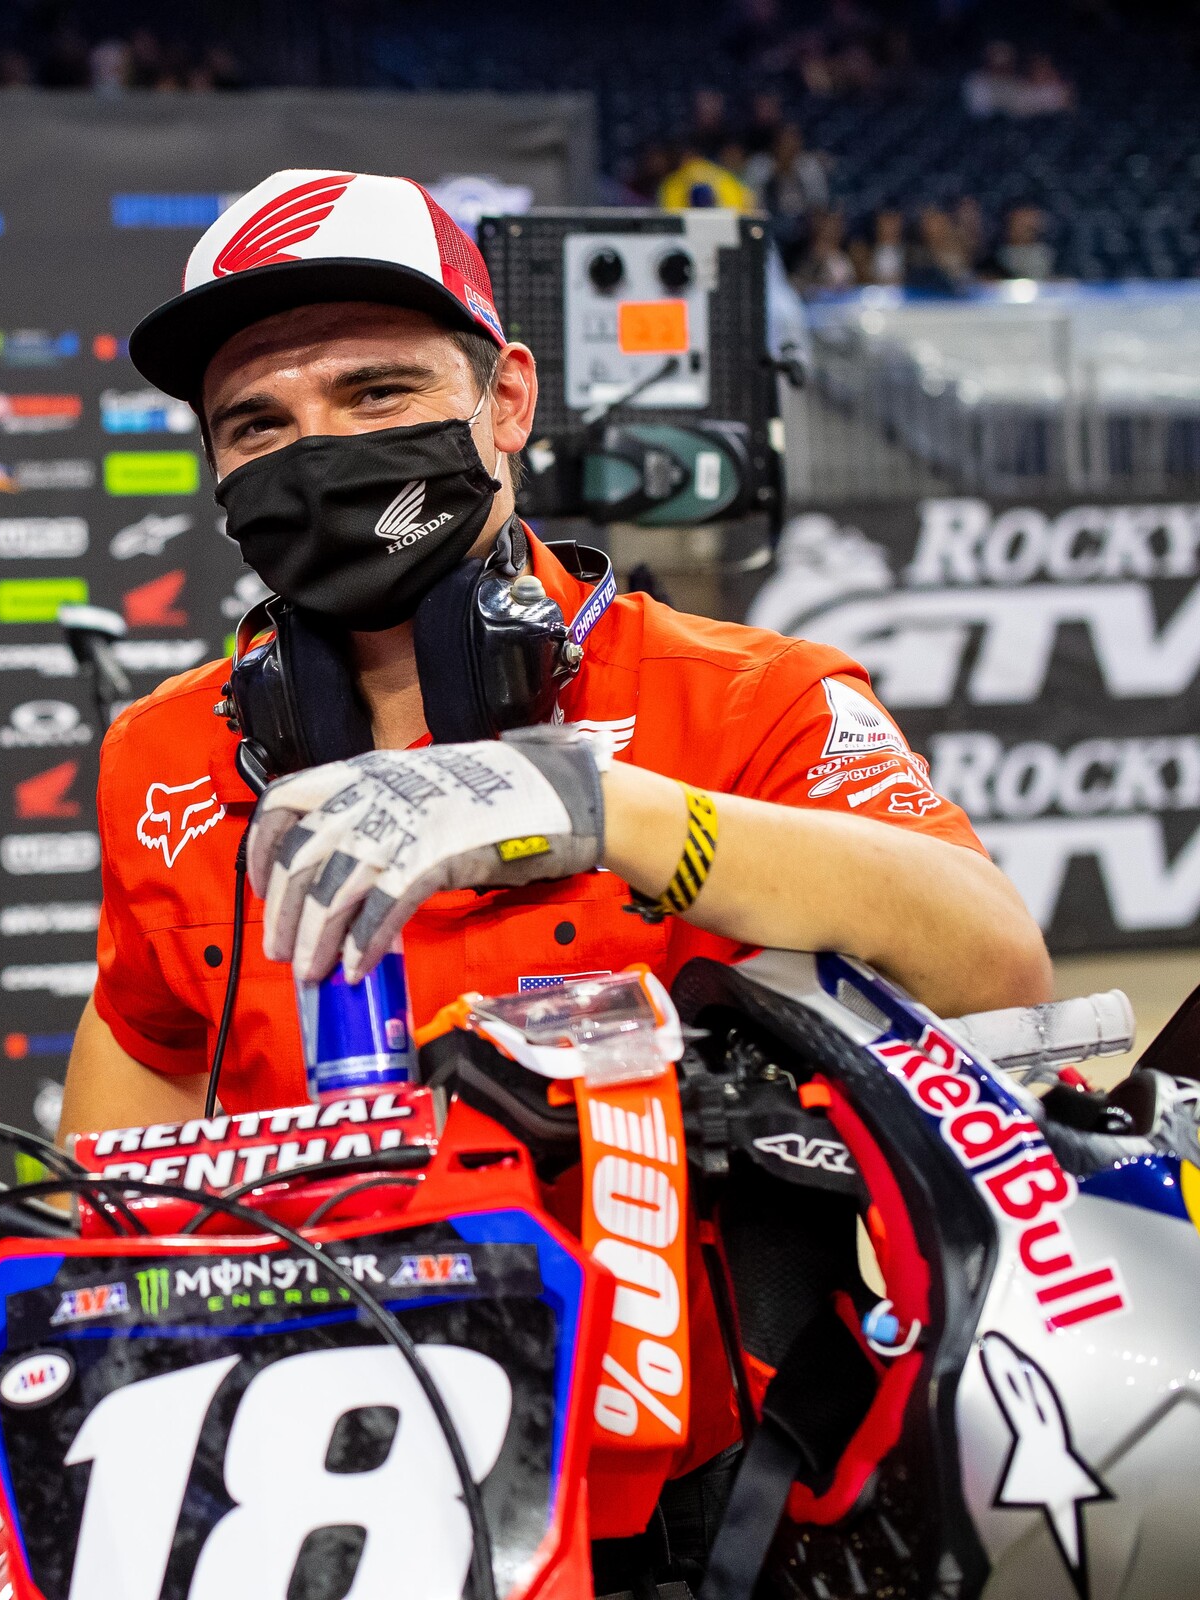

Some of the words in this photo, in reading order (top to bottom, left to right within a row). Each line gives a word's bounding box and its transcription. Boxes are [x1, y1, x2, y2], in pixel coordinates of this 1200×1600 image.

[386, 511, 455, 554] HONDA
[907, 498, 1200, 586] ROCKY
[839, 731, 864, 743] Pro
[94, 1092, 413, 1156] RENTHAL
[874, 1028, 1041, 1161] Red
[984, 1152, 1125, 1334] Bull
[175, 1253, 386, 1298] MONSTR
[588, 1096, 684, 1436] 100%
[63, 1342, 513, 1600] 18
